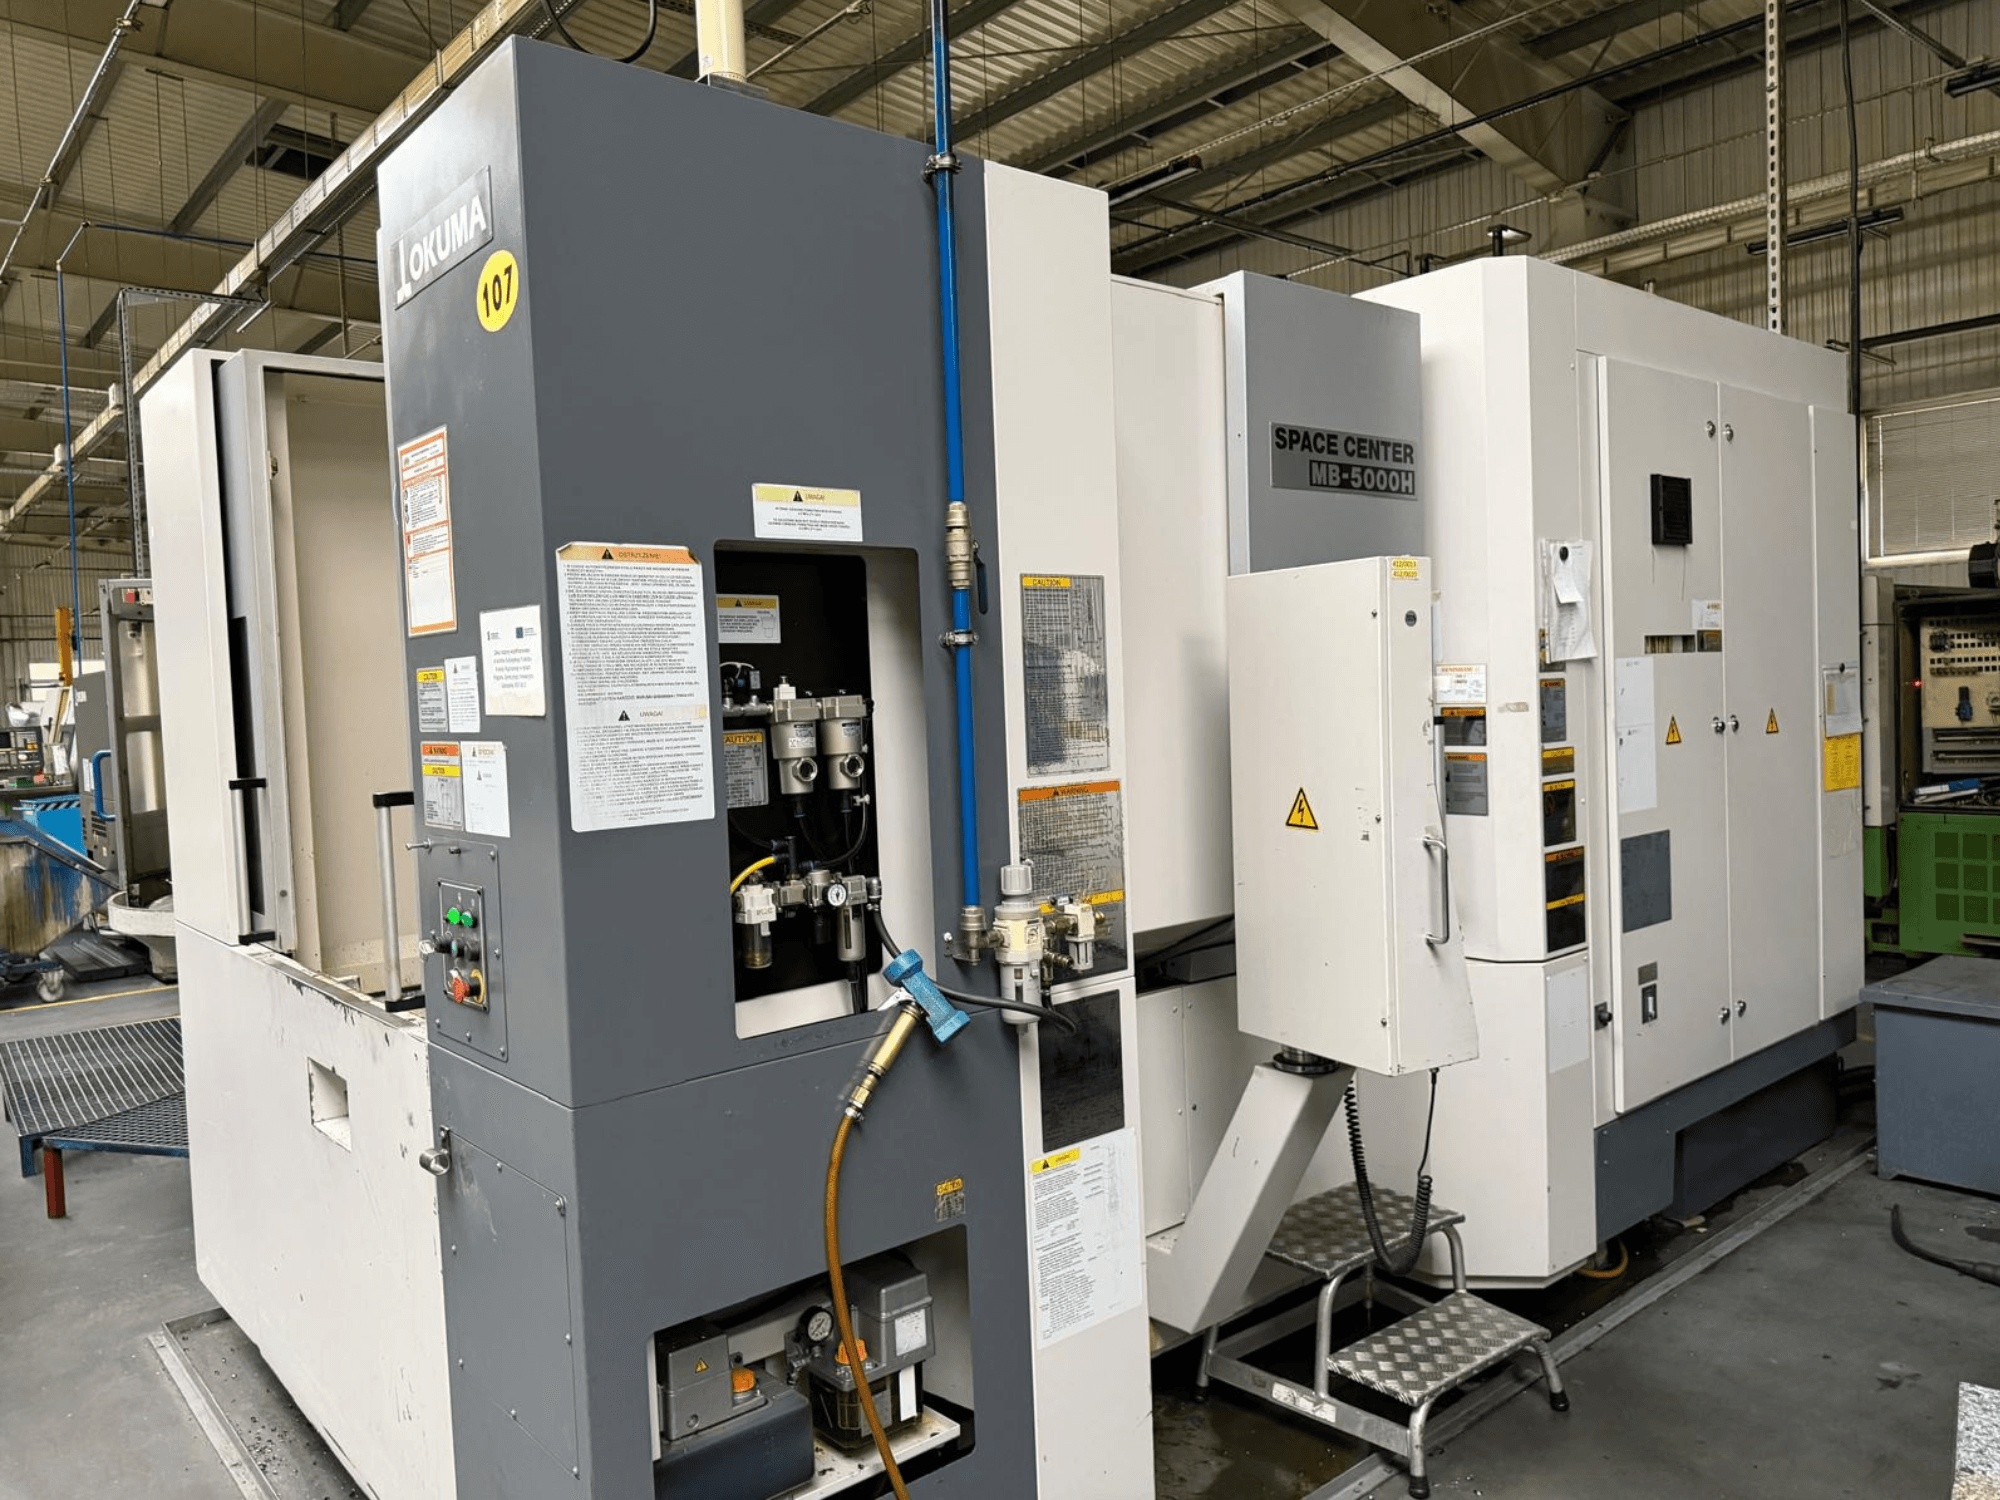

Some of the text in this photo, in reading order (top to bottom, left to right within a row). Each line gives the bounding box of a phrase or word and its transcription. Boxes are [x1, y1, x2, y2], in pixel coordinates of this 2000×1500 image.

[409, 194, 487, 281] OKUMA
[483, 264, 513, 318] 107
[1275, 427, 1414, 464] SPACE CENTER
[1312, 462, 1413, 493] MB-5000H
[725, 735, 757, 744] AUTION
